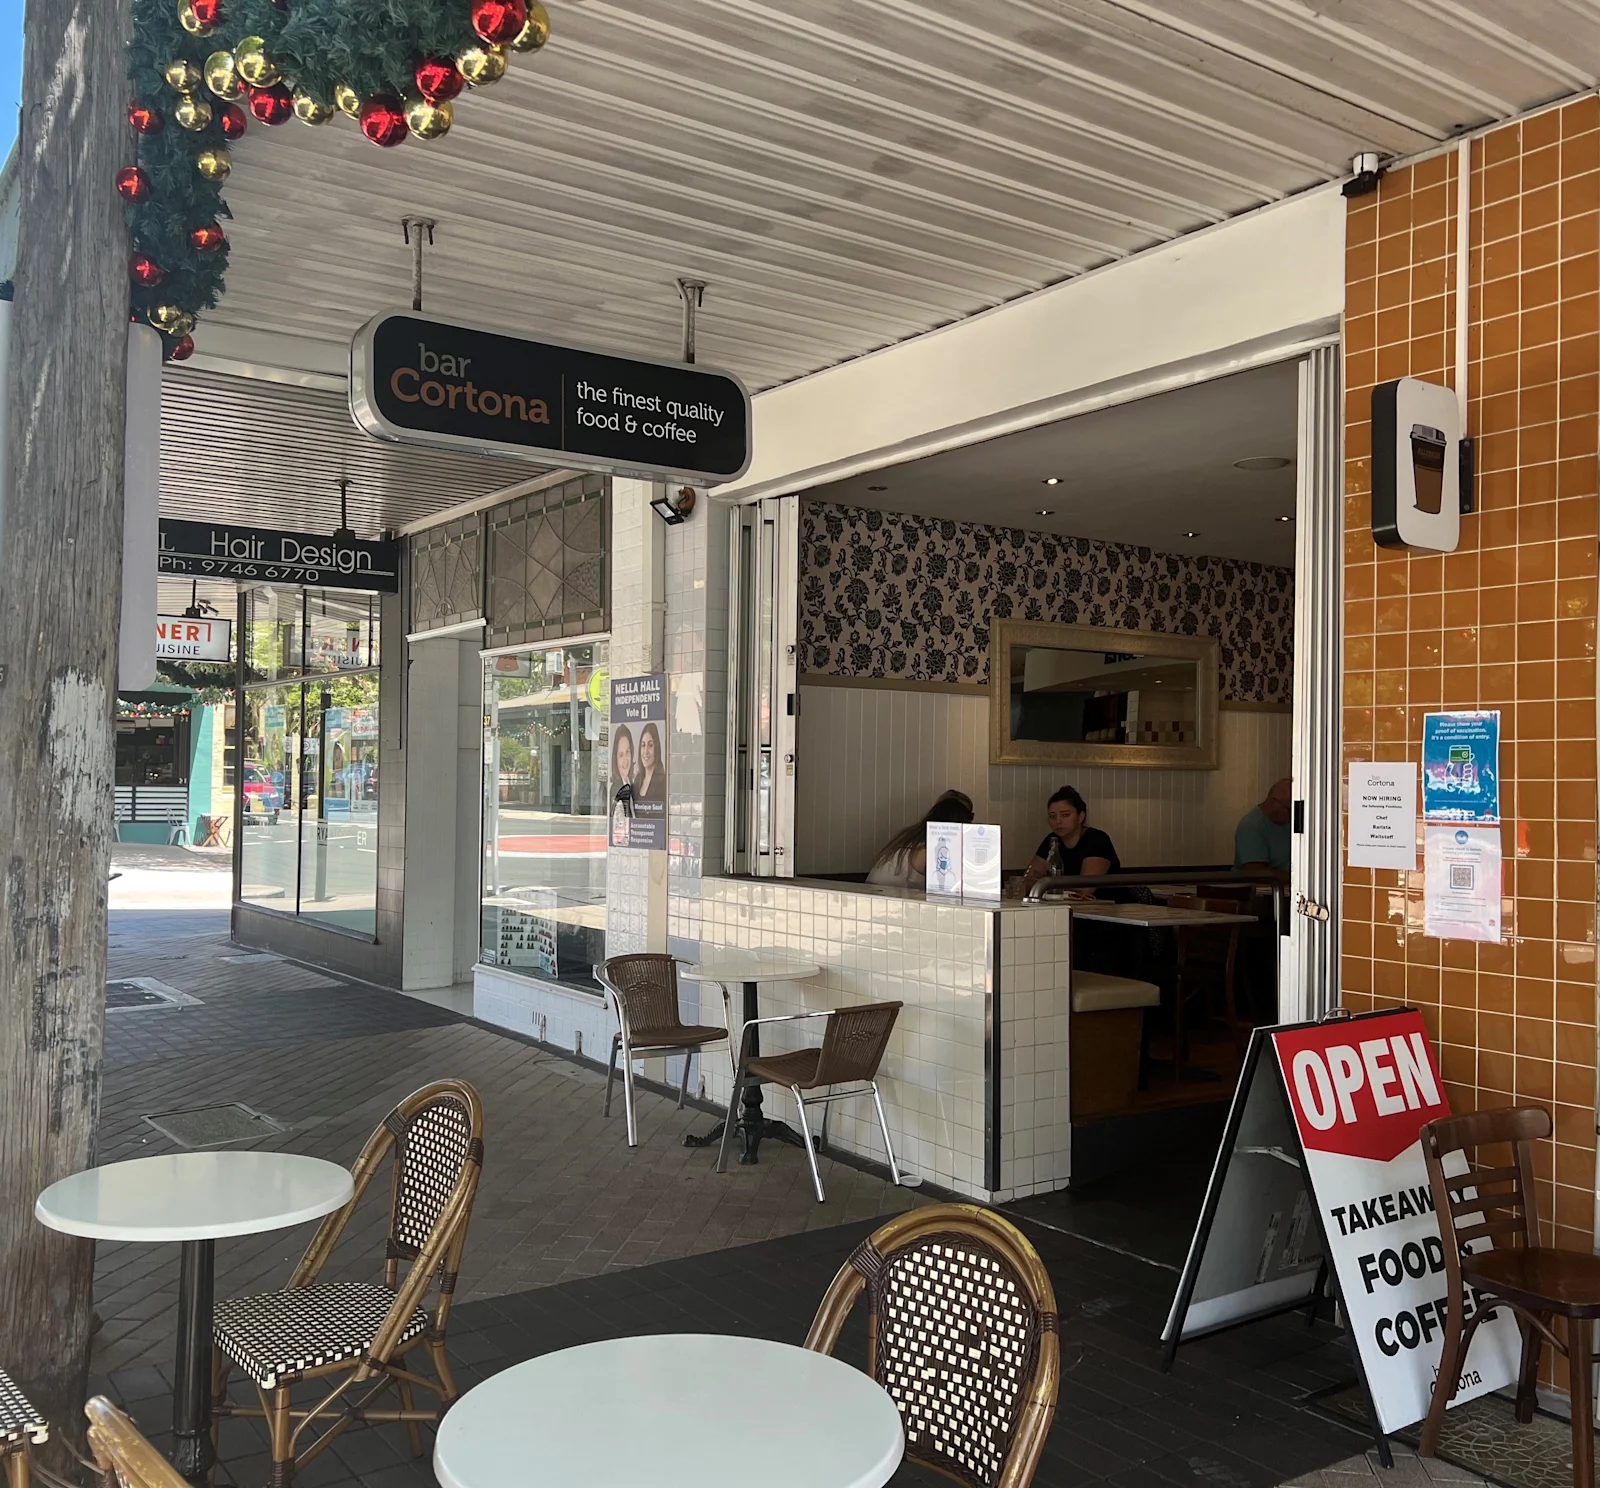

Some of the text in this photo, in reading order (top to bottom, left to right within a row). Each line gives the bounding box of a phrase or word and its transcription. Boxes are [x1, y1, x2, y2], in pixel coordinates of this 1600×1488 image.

[418, 342, 471, 378] bar
[390, 367, 549, 424] Cortona
[577, 381, 724, 427] the finest quality
[577, 407, 697, 443] food & coffee
[159, 556, 319, 582] Ph: 9746 6770
[211, 531, 265, 560] Hair
[281, 538, 372, 574] Design
[615, 680, 660, 695] NELLA HALL
[615, 692, 660, 705] INDEPENDENTS
[484, 716, 491, 726] 37
[626, 704, 648, 719] Vote 1
[1292, 1032, 1441, 1131] OPEN
[1331, 1183, 1466, 1236] TAKEAW
[1357, 1236, 1446, 1294] FOOD
